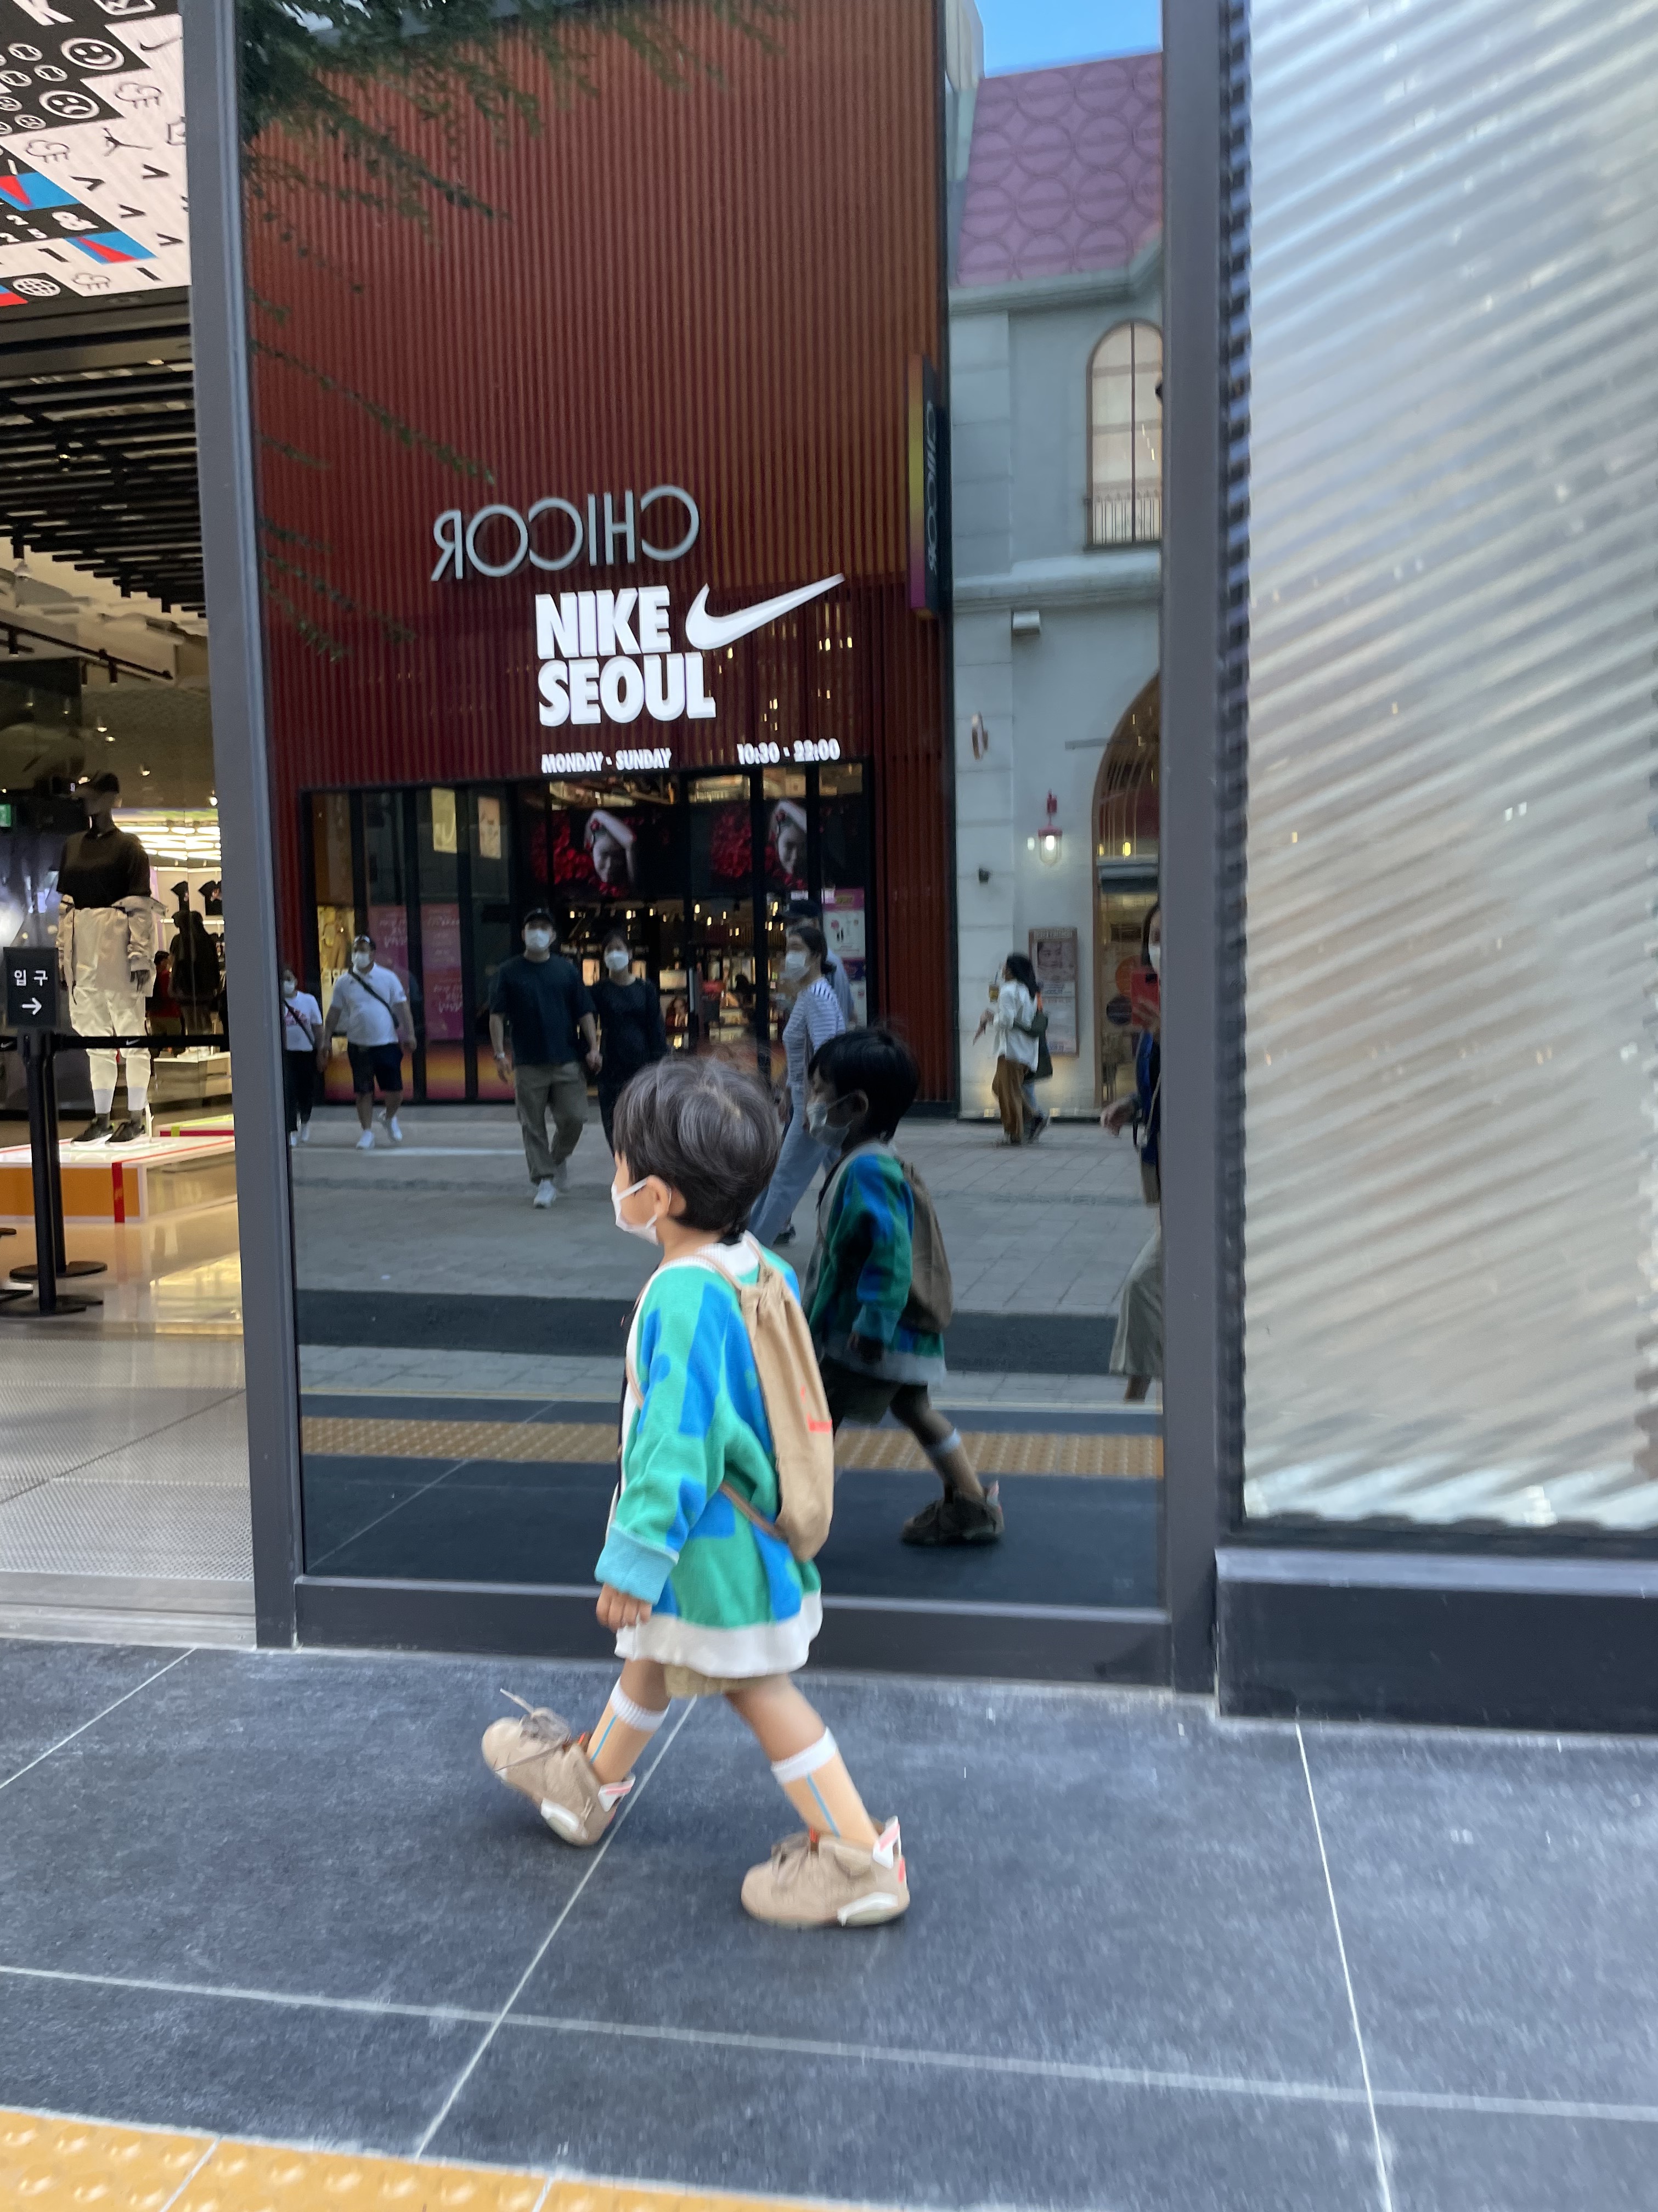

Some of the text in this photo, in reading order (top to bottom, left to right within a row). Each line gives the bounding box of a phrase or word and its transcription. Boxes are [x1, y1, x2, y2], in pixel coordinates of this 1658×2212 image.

[535, 585, 671, 659] NIKE
[538, 651, 716, 726] SEOUL
[542, 751, 604, 774] MONDAY
[616, 747, 672, 771] SUNDAY
[737, 741, 780, 764] 10:30
[793, 738, 841, 762] 22:00
